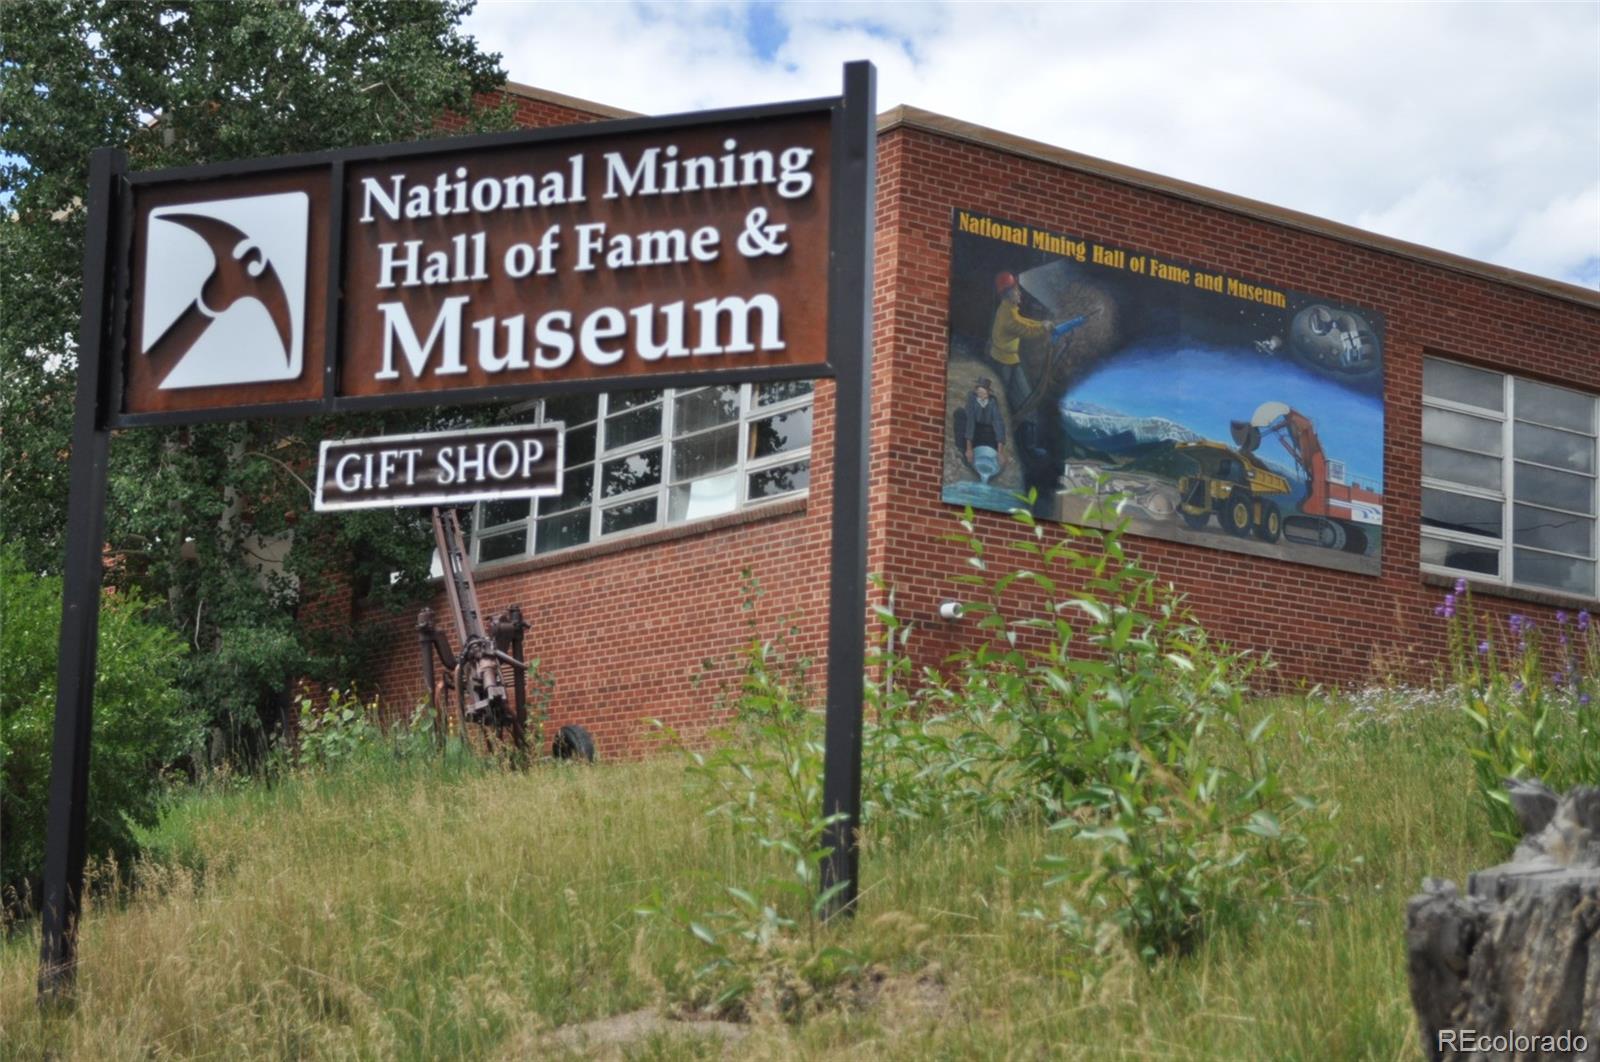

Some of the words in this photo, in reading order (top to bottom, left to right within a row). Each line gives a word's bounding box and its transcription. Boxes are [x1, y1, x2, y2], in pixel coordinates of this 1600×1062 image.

[359, 153, 586, 223] National
[602, 138, 814, 199] Mining
[376, 231, 489, 289] Hall
[504, 224, 560, 279] of
[574, 222, 720, 272] Fame
[737, 206, 788, 257] &
[958, 211, 1028, 247] National
[1032, 230, 1086, 263] Mining
[1092, 245, 1125, 270] Hall
[1129, 256, 1146, 274] of
[1149, 258, 1190, 286] Fame
[1194, 267, 1223, 293] and
[1226, 278, 1287, 309] Museum
[374, 294, 786, 380] Museum
[335, 448, 423, 492] GIFT
[436, 439, 544, 485] SHOP
